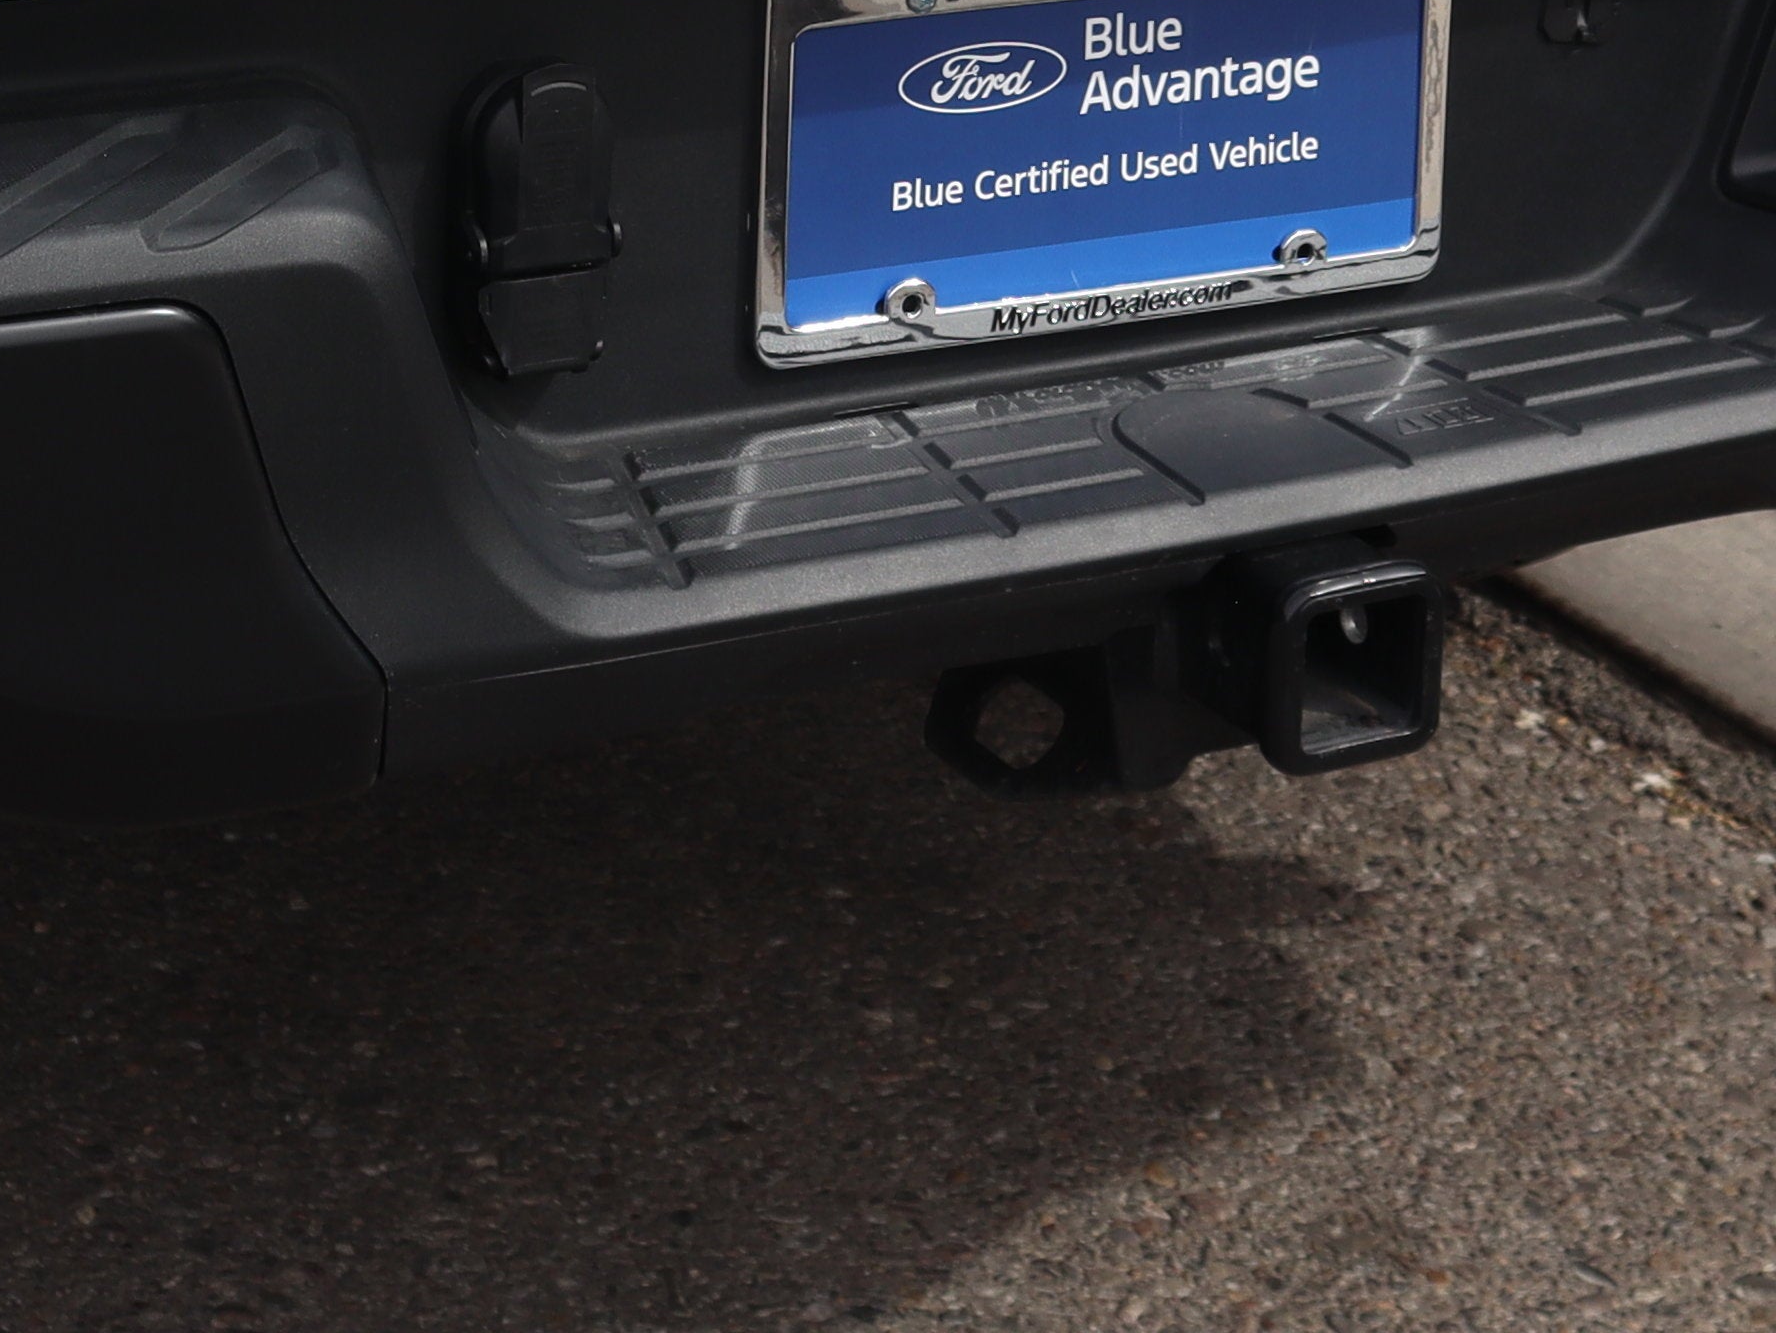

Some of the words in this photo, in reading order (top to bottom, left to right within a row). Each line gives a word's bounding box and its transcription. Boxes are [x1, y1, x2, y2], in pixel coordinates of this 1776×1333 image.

[1084, 12, 1183, 61] Blue
[930, 51, 1036, 104] Ford
[1079, 53, 1320, 115] Advantage
[892, 178, 964, 211] Blue
[974, 155, 1109, 201] Certified
[1121, 144, 1199, 182] Used
[1209, 132, 1320, 171] Vehicle
[990, 281, 1233, 335] MyFordDealer.com
